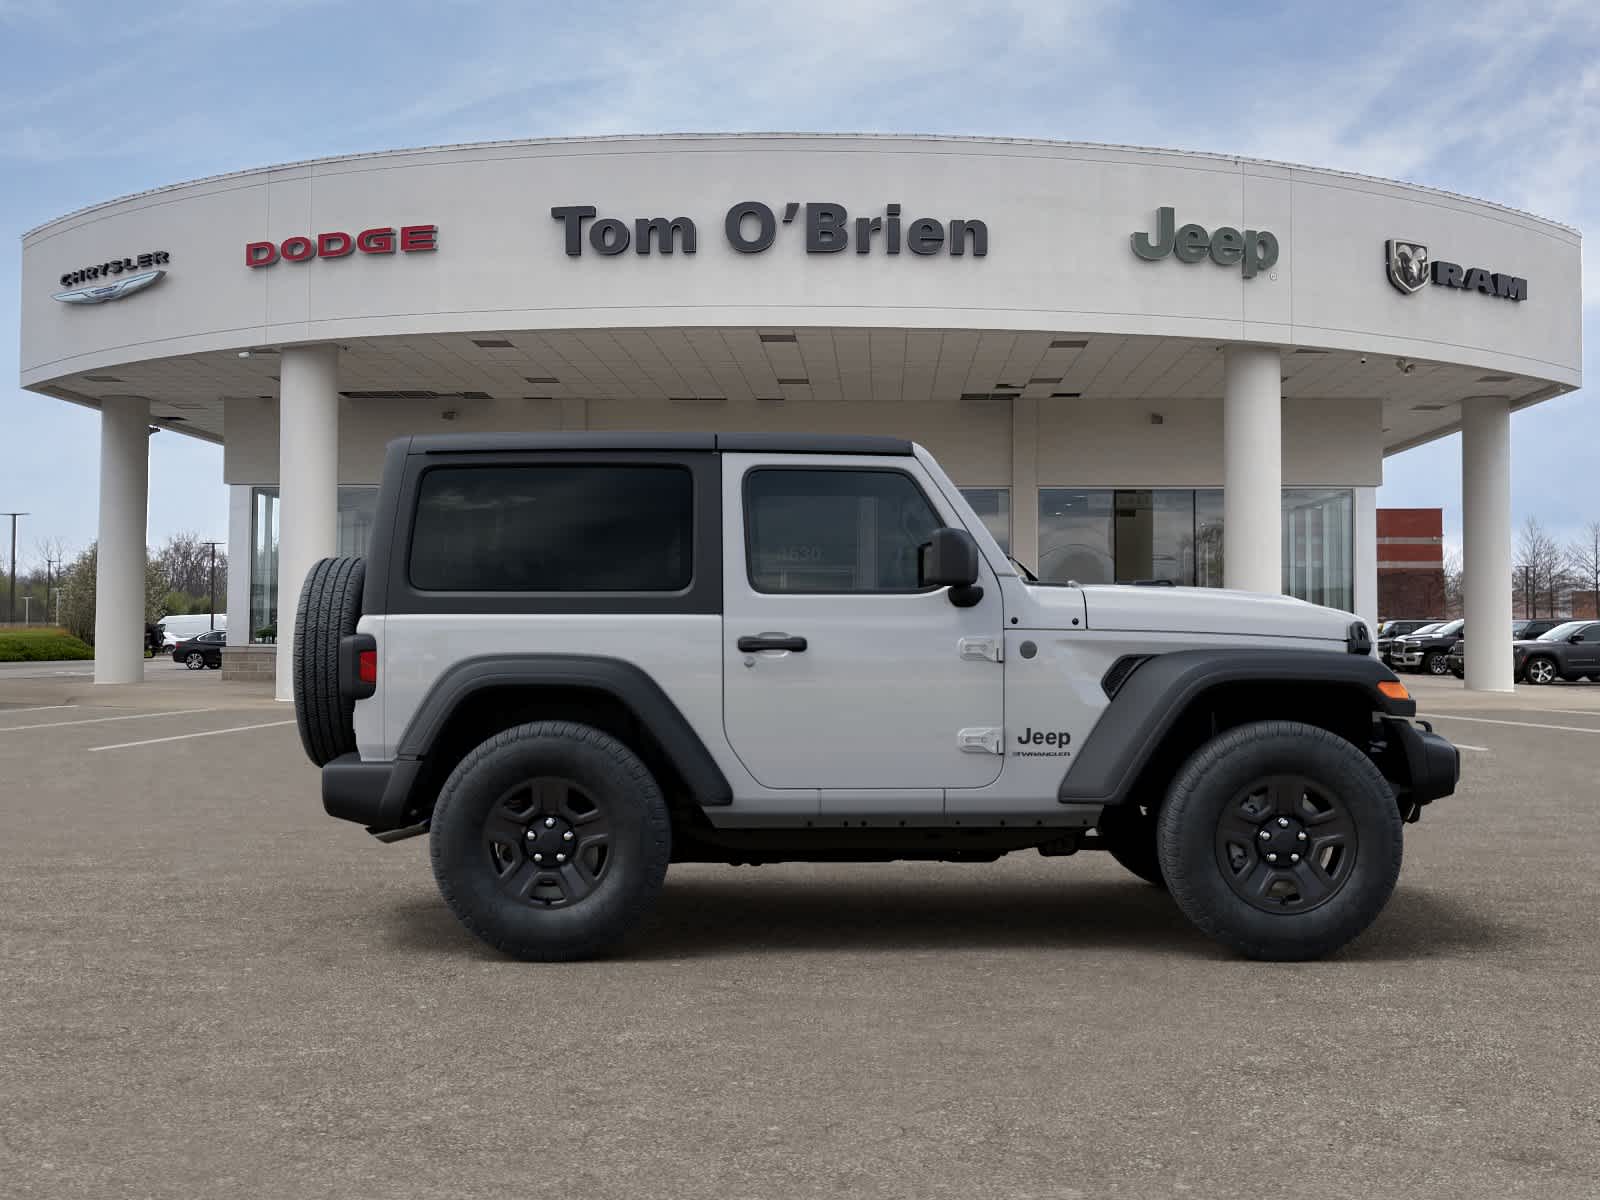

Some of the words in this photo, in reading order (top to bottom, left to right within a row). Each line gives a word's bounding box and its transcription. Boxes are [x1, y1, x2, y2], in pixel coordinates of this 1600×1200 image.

[245, 224, 439, 270] DODGE
[551, 205, 697, 256] Tom
[1130, 206, 1280, 279] Jeep
[60, 250, 170, 287] CHRYSLER
[1430, 260, 1528, 301] RAM
[1017, 727, 1071, 749] Jeep
